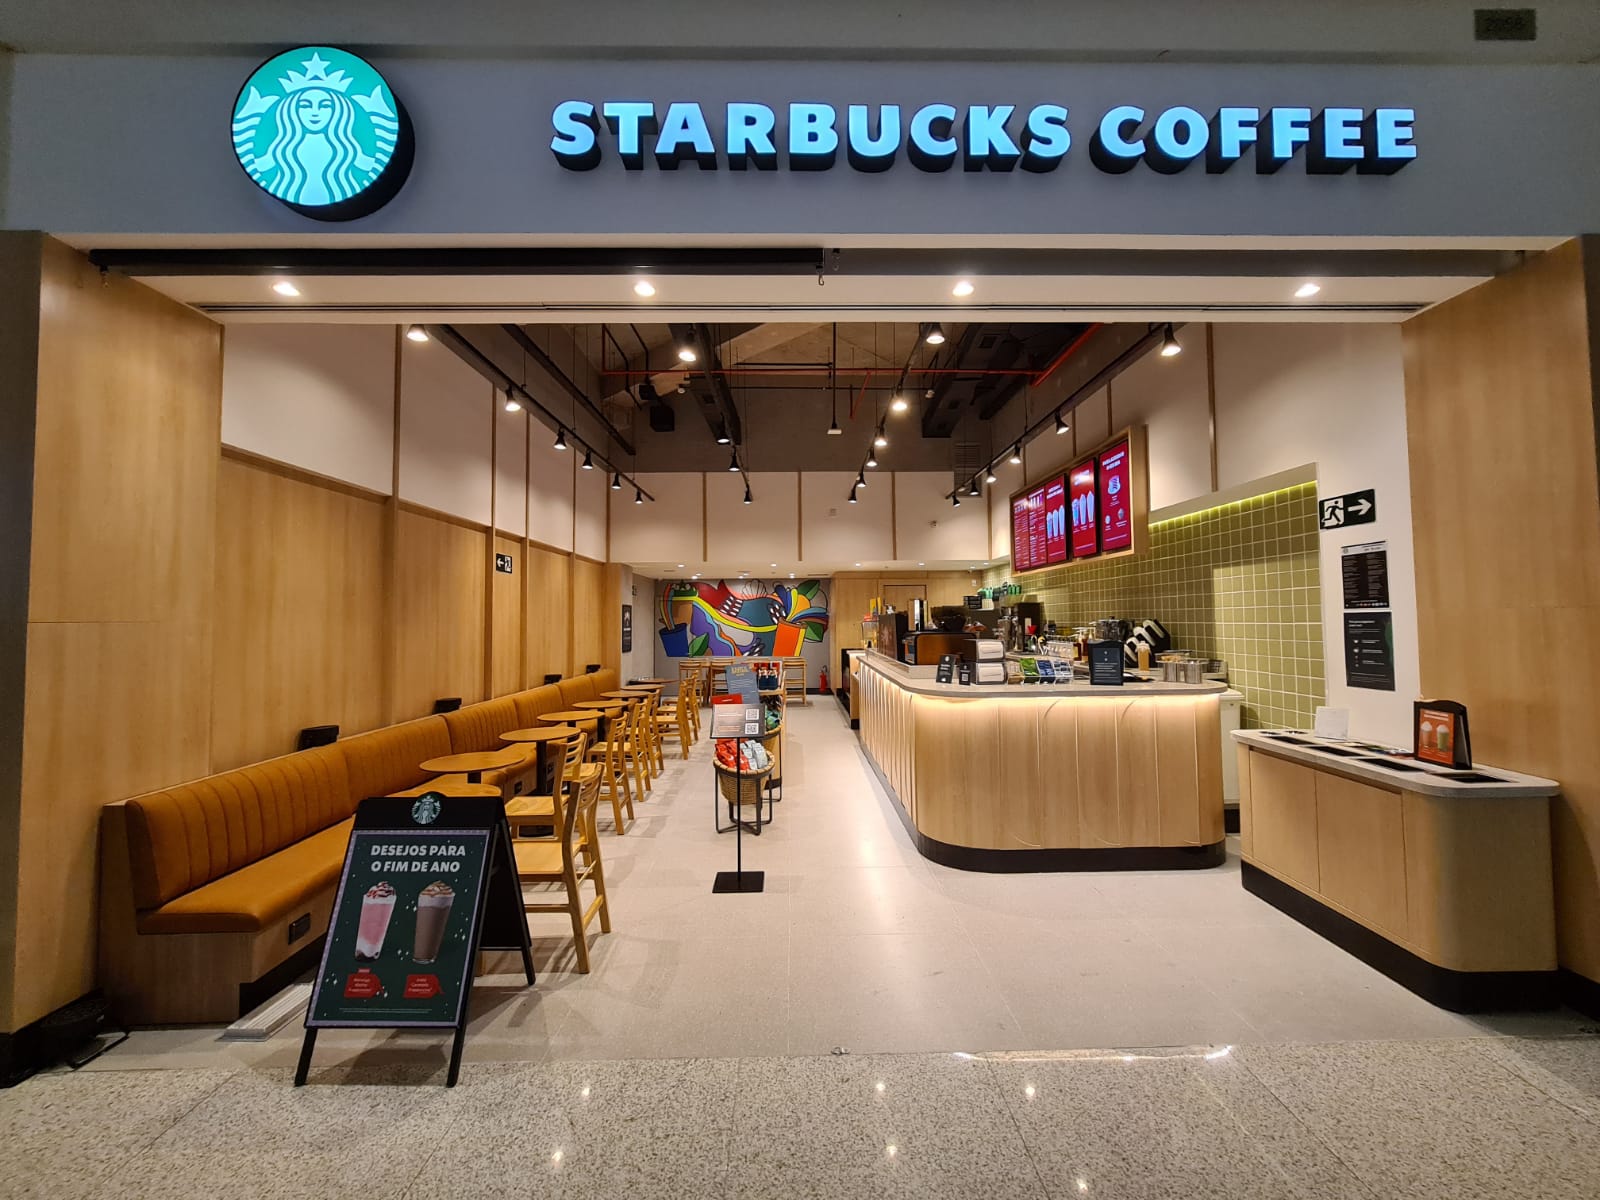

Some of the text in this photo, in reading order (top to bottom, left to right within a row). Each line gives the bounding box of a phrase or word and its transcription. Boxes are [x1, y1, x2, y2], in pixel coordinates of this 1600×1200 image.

[549, 101, 1418, 161] STARBUCKS COFFEE
[370, 845, 466, 856] DESEJOS PARA
[371, 861, 460, 872] O FIM DE ANO
